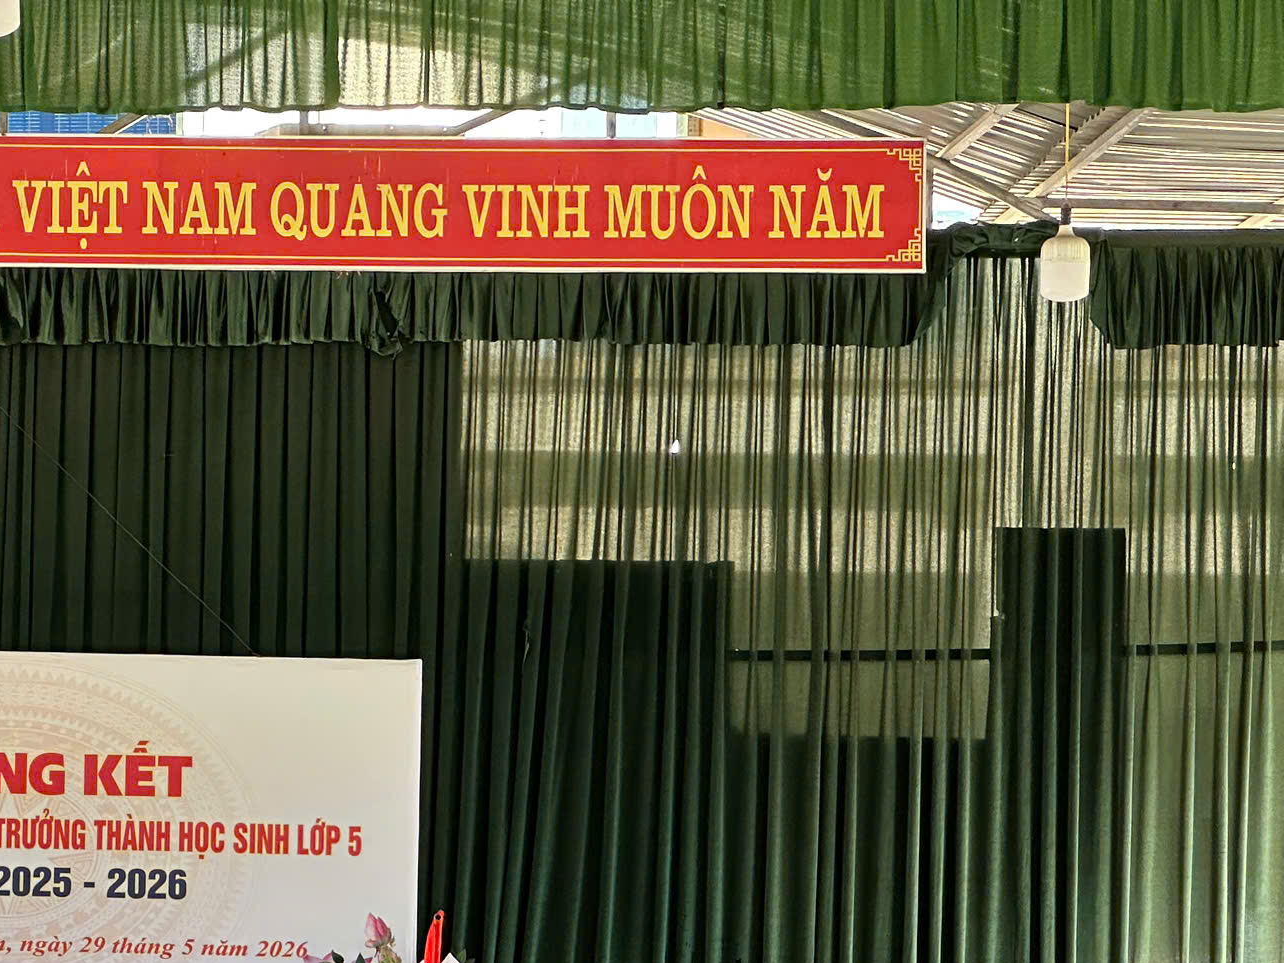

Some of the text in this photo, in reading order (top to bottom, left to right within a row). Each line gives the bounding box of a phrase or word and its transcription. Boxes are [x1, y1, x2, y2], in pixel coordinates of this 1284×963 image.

[12, 161, 128, 250] VIỆT
[141, 181, 257, 236] NAM
[270, 181, 448, 240] QUANG
[461, 184, 591, 238] VINH
[603, 166, 752, 239] MUÔN
[768, 167, 885, 239] NĂM
[83, 740, 193, 798] KẾT
[93, 816, 171, 852] THÀNH
[178, 821, 225, 860] HỌC
[233, 823, 290, 855] SINH
[297, 818, 341, 856] LỚP
[348, 826, 362, 857] 5
[106, 867, 187, 900] 2026
[20, 936, 73, 958] ngày
[80, 936, 106, 953] 29
[112, 938, 175, 960] tháng
[183, 938, 196, 954] 5
[202, 939, 249, 957] năm
[256, 940, 309, 959] 2026
